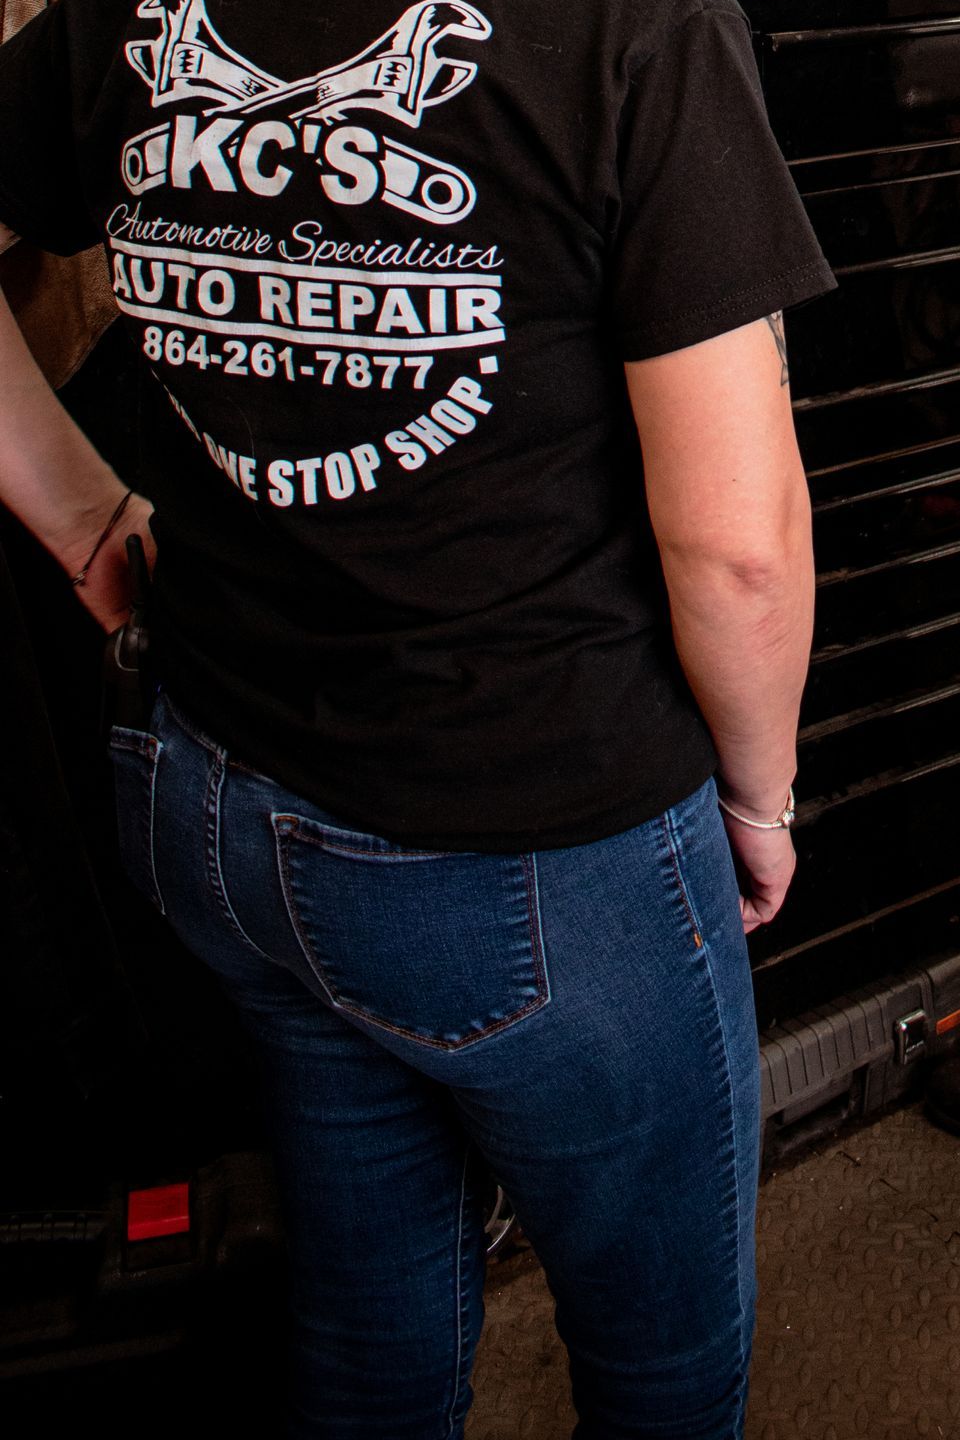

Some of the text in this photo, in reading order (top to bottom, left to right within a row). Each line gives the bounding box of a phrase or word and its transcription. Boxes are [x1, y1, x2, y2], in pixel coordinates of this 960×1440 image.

[170, 114, 384, 205] KC'S
[105, 202, 504, 269] Automotive Specialists
[112, 253, 505, 334] AUTO REPAIR
[143, 324, 434, 390] 864-261-7877
[267, 442, 383, 508] STOP
